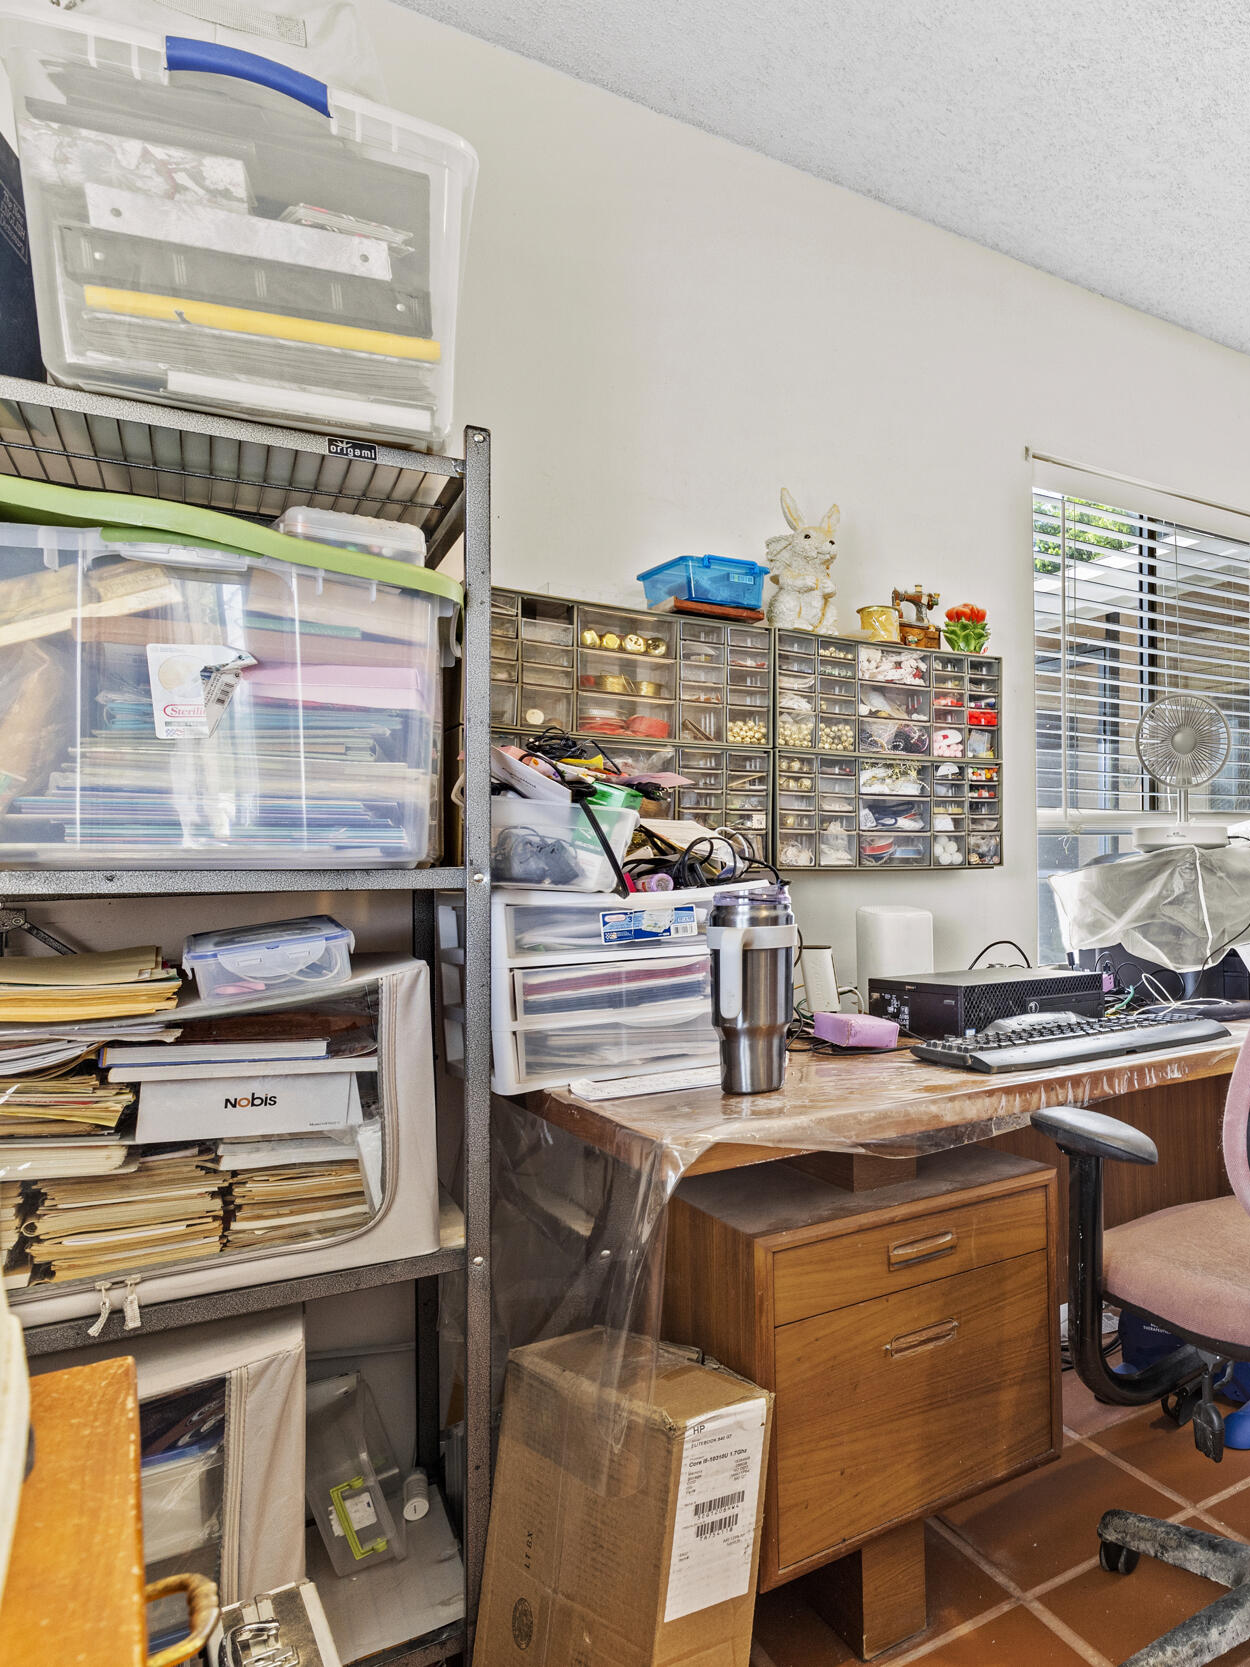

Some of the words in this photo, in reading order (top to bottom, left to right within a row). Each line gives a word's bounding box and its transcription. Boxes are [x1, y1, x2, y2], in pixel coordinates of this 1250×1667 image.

[330, 444, 375, 459] origami
[224, 1092, 277, 1109] Nobis
[693, 1425, 705, 1435] HP
